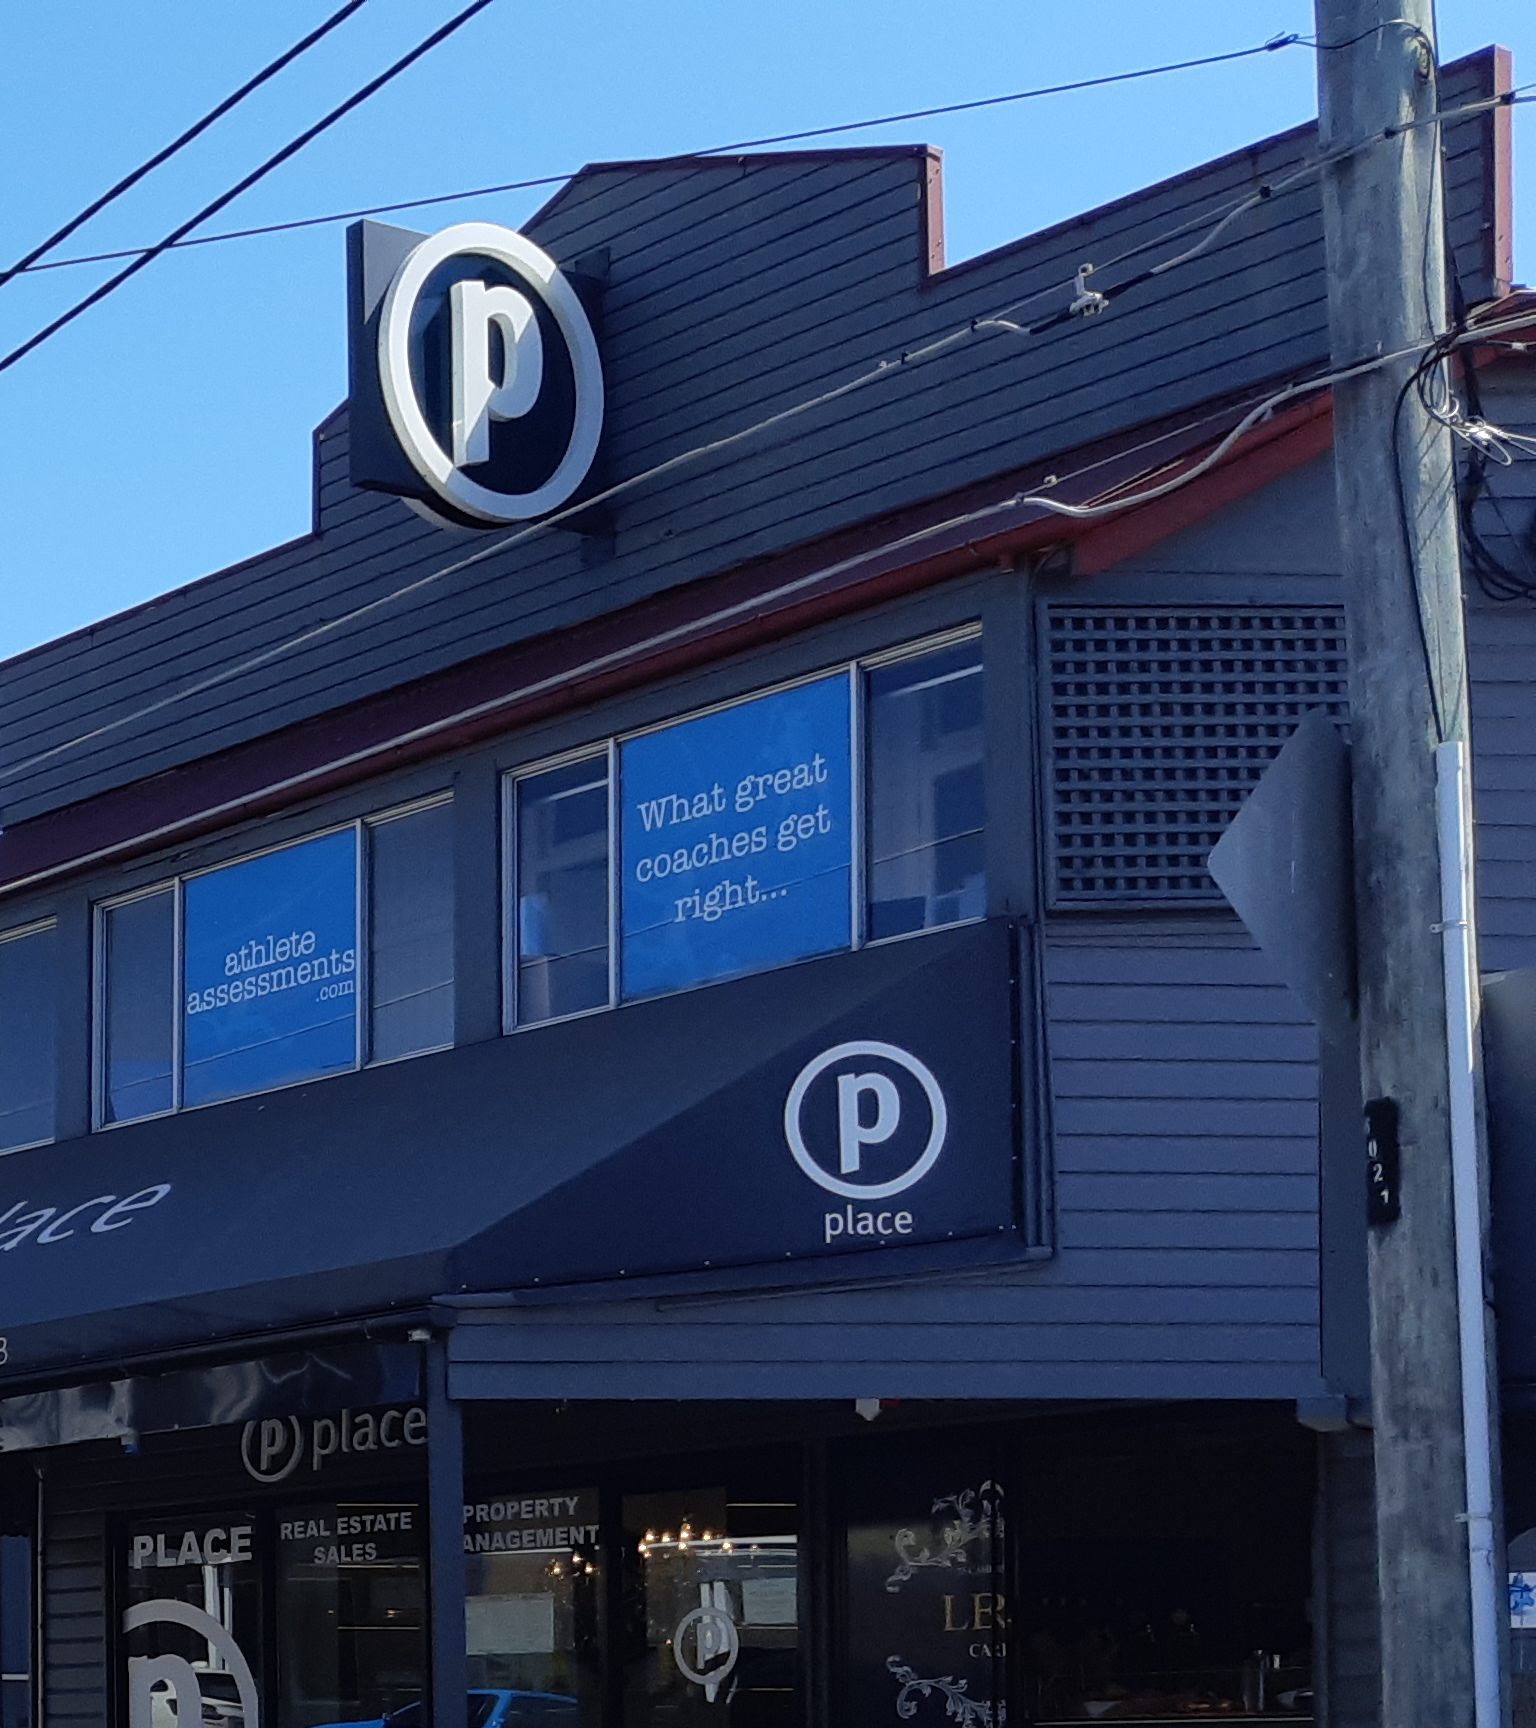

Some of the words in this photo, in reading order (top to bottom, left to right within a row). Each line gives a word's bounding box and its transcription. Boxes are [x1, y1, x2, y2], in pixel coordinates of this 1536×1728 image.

[636, 782, 727, 832] What
[735, 752, 828, 813] great
[636, 825, 768, 883] coaches
[777, 803, 832, 852] get
[674, 874, 788, 922] right...
[224, 930, 316, 977] athlete
[187, 948, 356, 1015] assessments
[315, 979, 355, 1003] .com
[824, 1203, 913, 1244] place
[312, 1406, 427, 1471] place
[280, 1519, 331, 1541] REAL
[336, 1511, 413, 1536] ESTATE
[462, 1496, 580, 1524] PROPERTY
[133, 1525, 253, 1570] PLACE
[313, 1542, 377, 1565] SALES
[462, 1524, 600, 1555] ANAGEMENT
